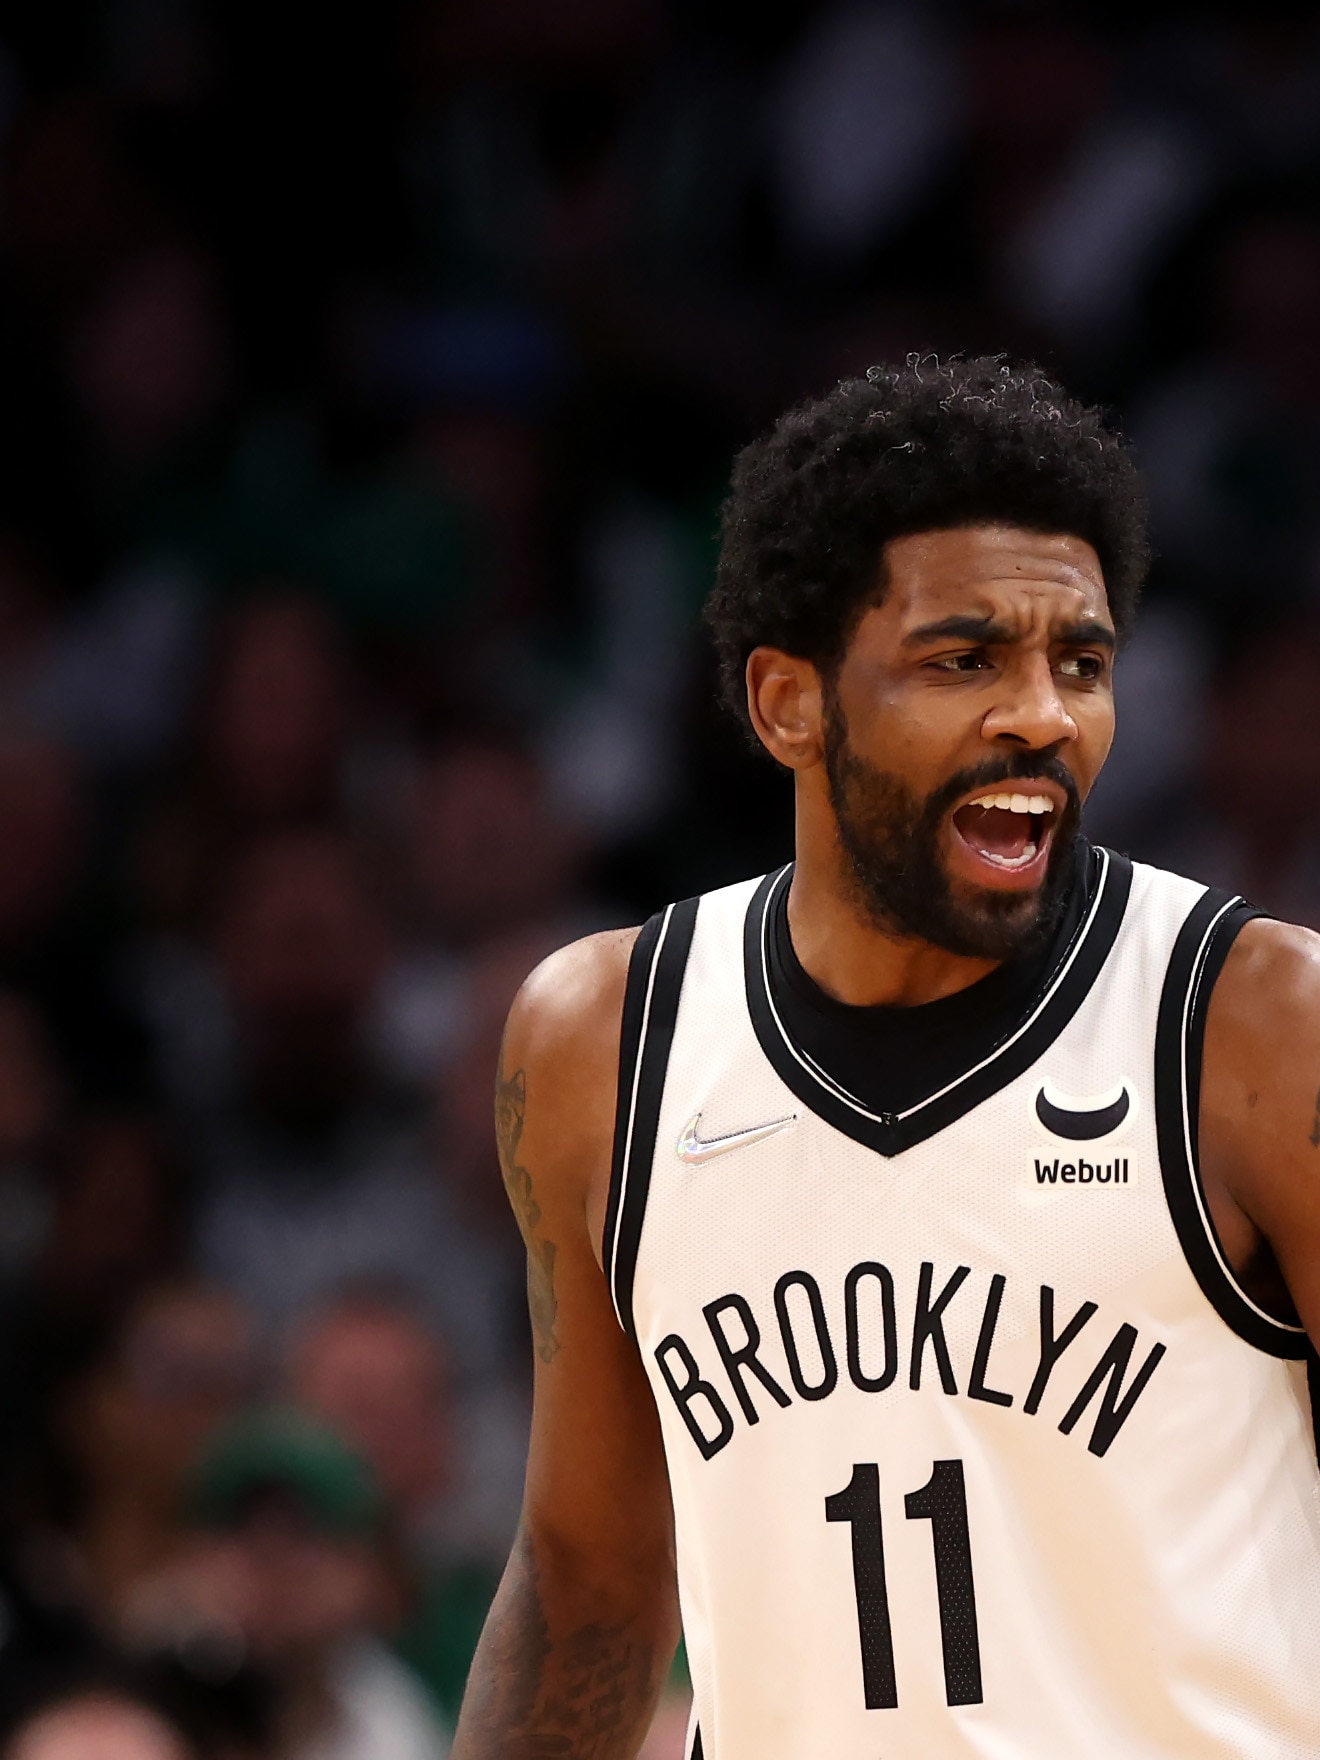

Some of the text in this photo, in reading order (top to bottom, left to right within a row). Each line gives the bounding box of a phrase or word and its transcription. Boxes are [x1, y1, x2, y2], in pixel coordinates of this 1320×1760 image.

[1033, 1157, 1129, 1185] Webull
[654, 1261, 1167, 1462] BROOKLYN
[824, 1459, 984, 1710] 11
